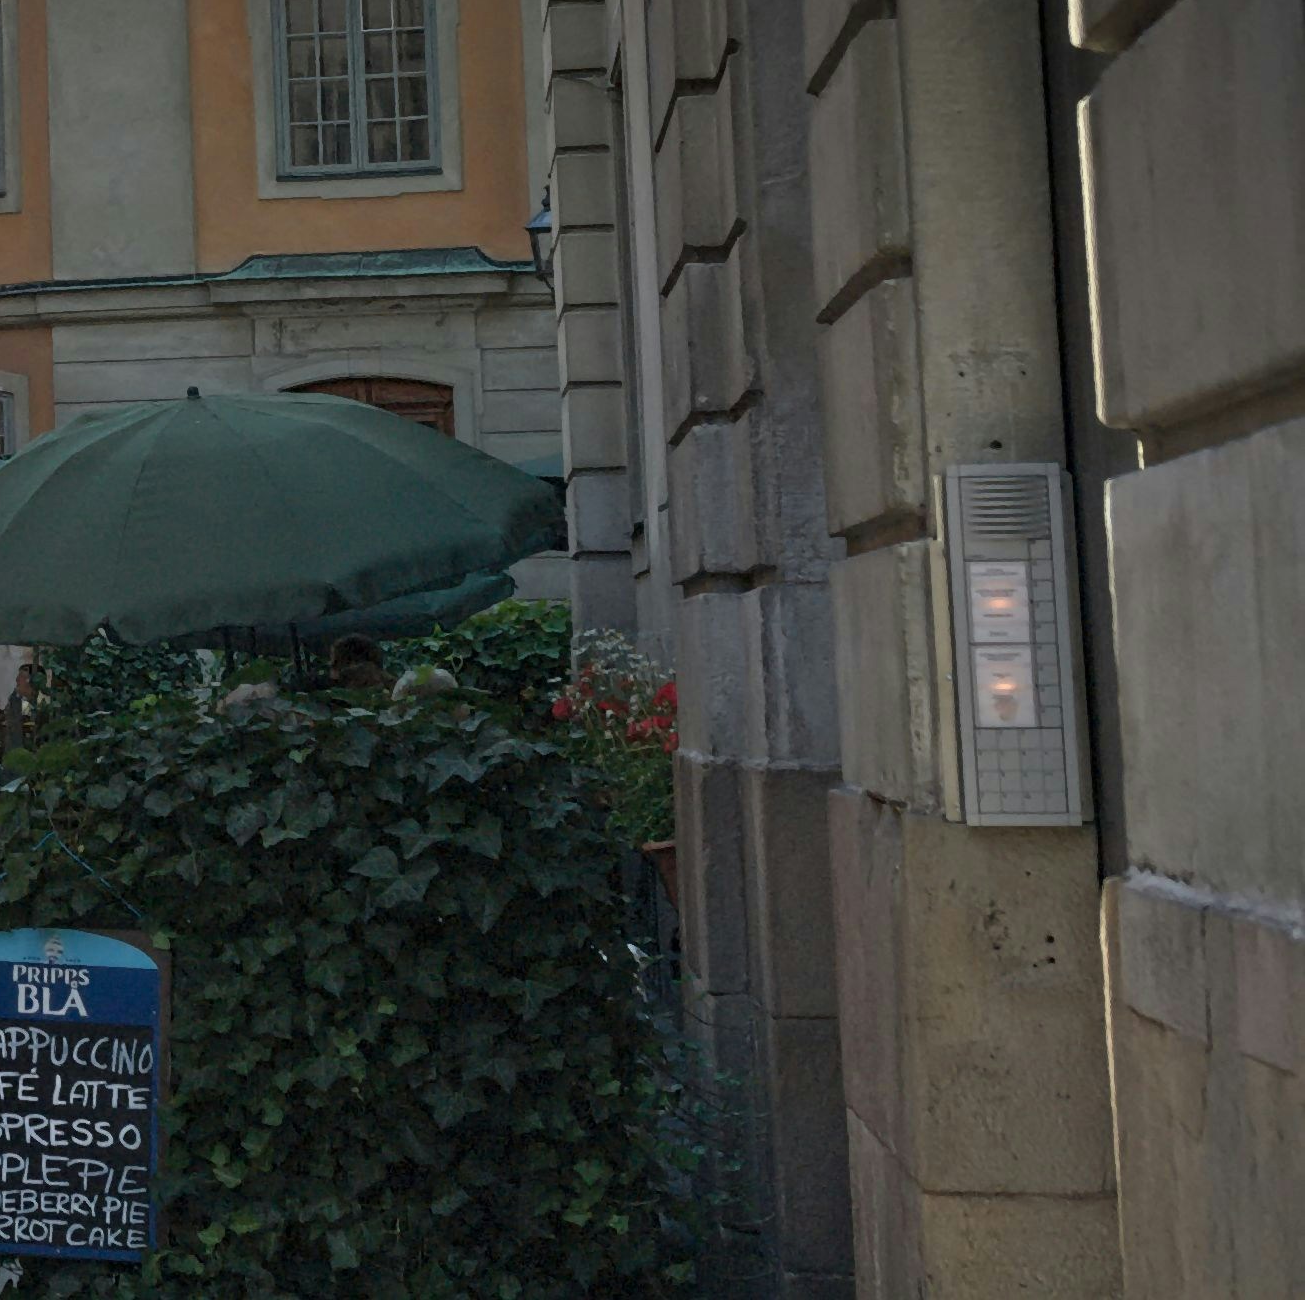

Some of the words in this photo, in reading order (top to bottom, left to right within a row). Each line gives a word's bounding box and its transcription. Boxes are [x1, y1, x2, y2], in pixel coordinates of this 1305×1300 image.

[12, 964, 90, 987] PRIPPS
[17, 980, 89, 1017] BLÅ
[52, 1074, 151, 1110] LATTE
[67, 1158, 148, 1195] PIE
[102, 1196, 150, 1226] PIE
[66, 1222, 149, 1249] CAKE
